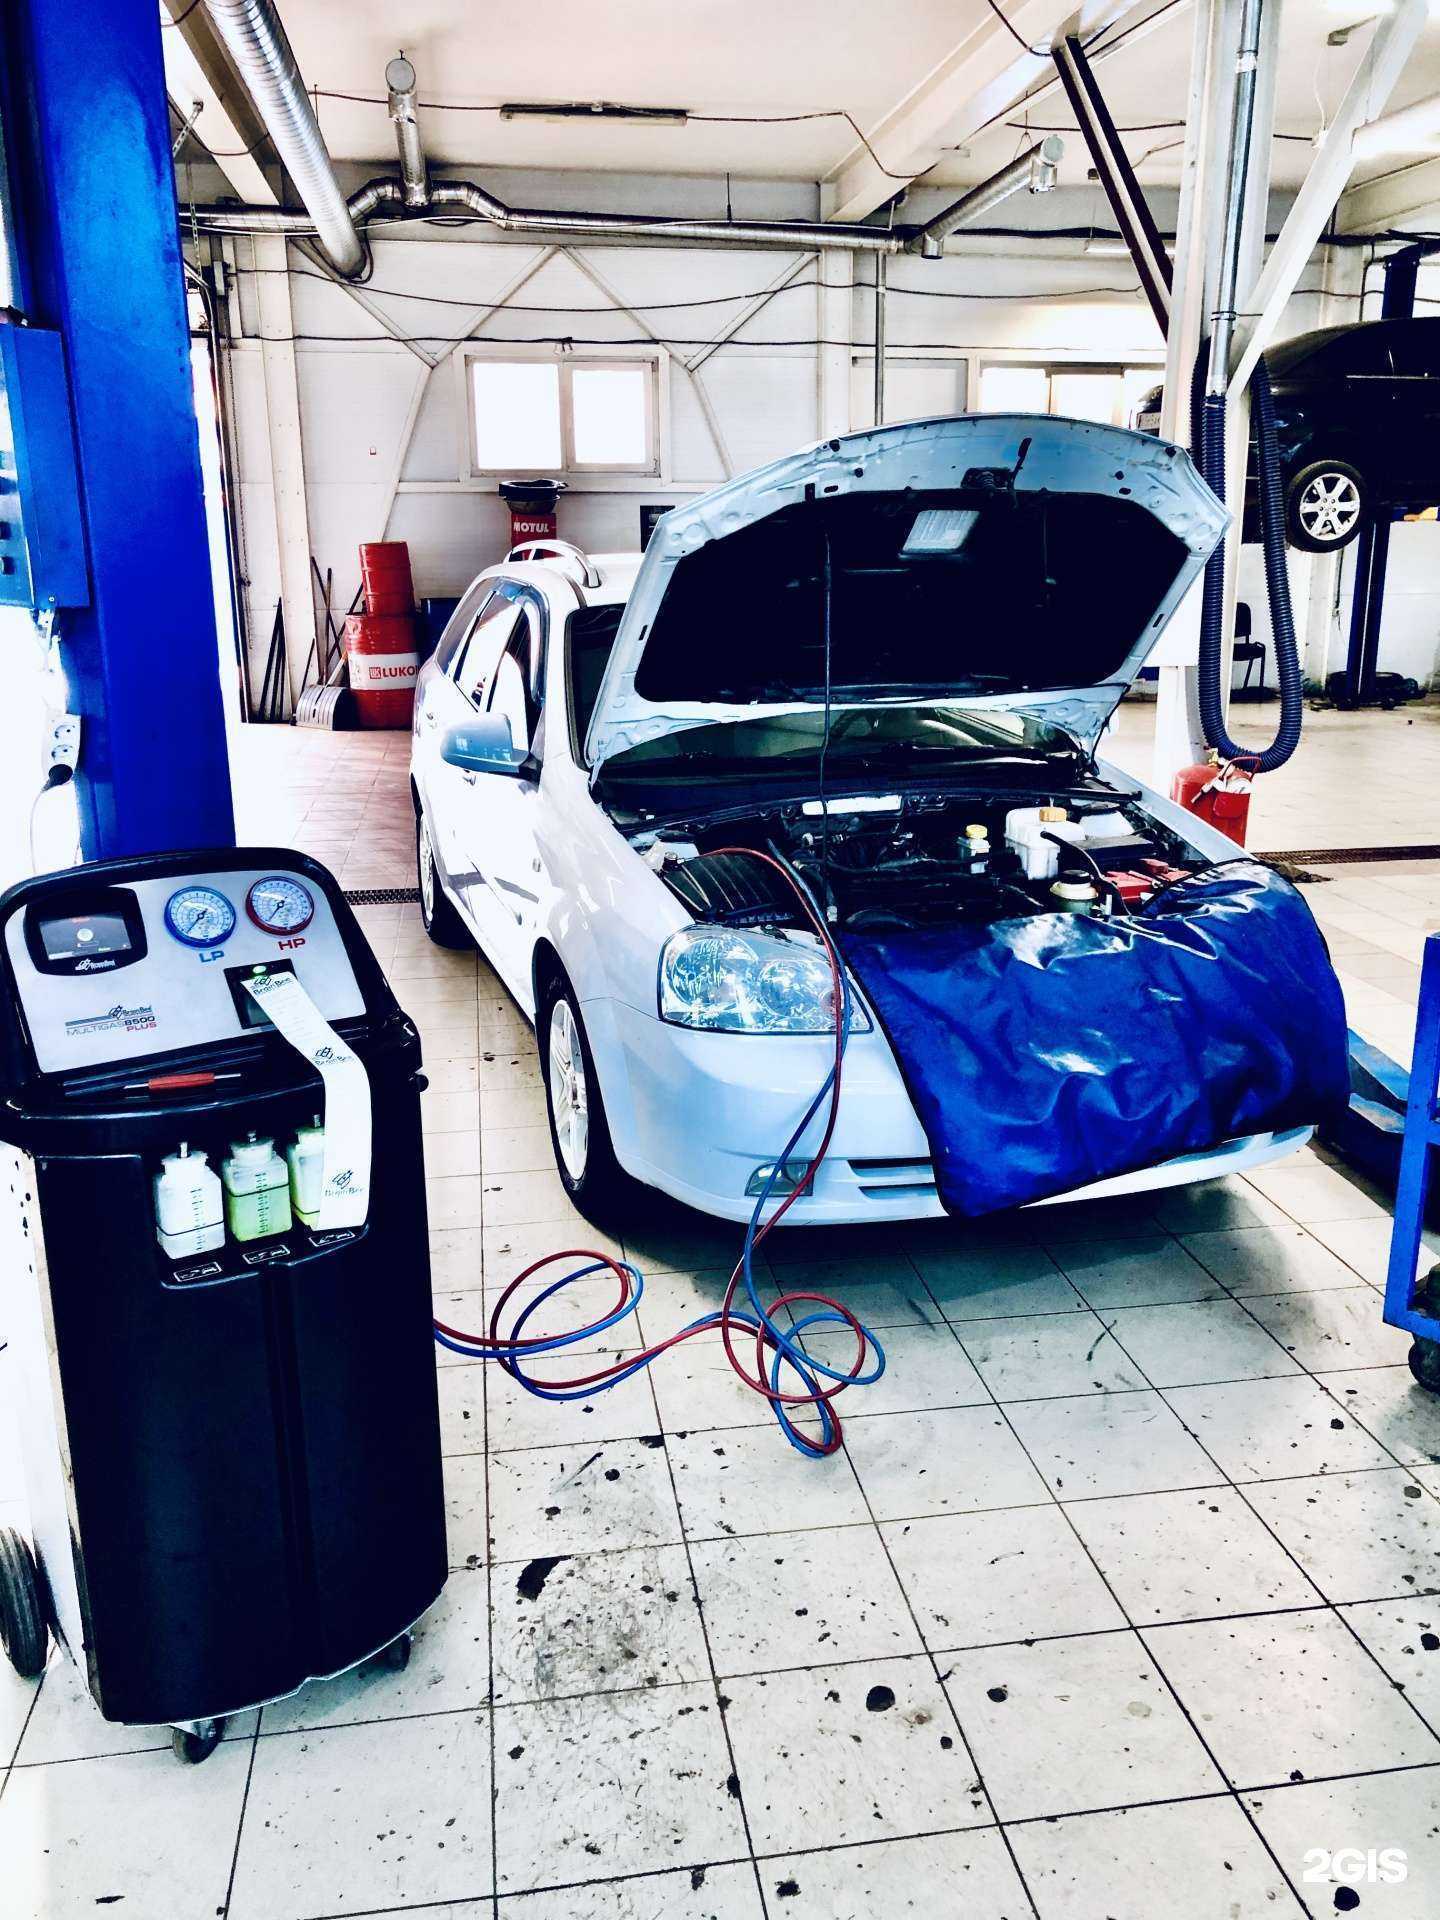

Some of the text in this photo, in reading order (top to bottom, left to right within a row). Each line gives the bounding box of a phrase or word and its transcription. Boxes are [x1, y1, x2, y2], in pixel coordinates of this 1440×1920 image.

[513, 521, 549, 533] MOTUL
[278, 938, 306, 951] HP
[199, 950, 225, 963] LP
[126, 1021, 157, 1032] PLUS
